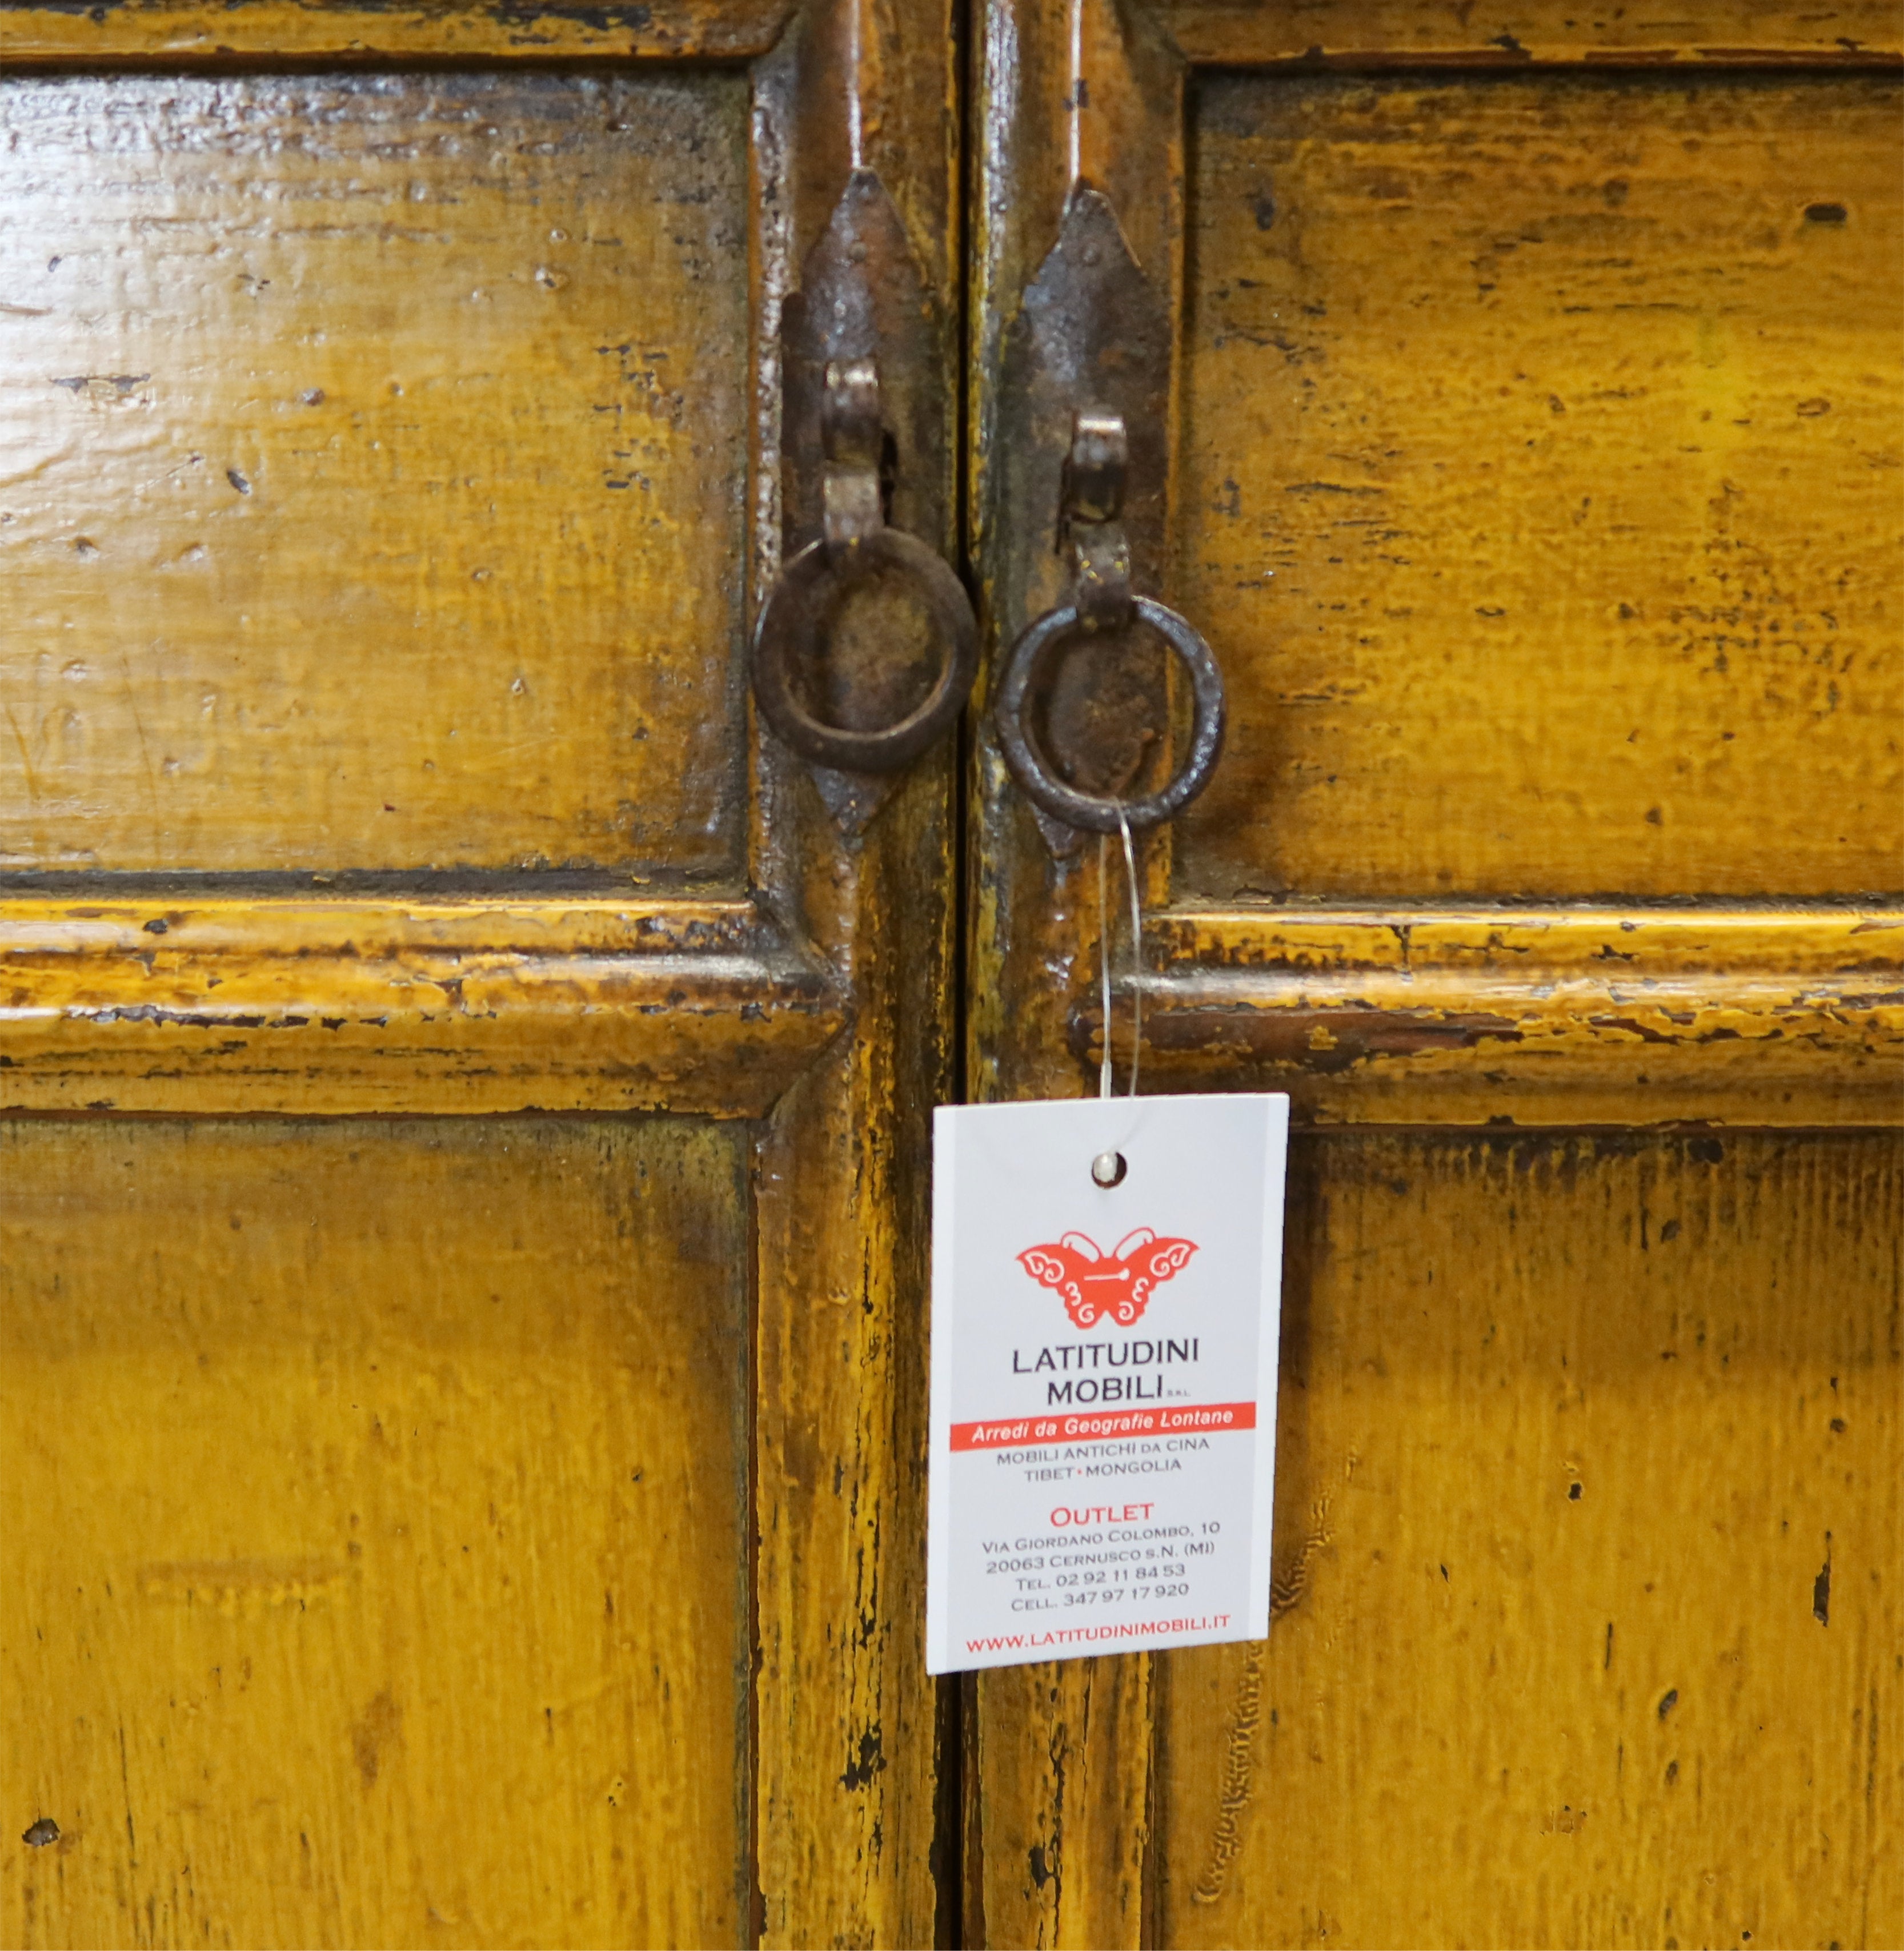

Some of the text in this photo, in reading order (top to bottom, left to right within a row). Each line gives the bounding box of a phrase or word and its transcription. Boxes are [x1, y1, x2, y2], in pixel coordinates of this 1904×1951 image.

[1013, 1338, 1200, 1374] LATITUDINI
[1047, 1375, 1164, 1406] MOBILI
[971, 1408, 1233, 1443] Arredi da Geografie Lontane
[996, 1448, 1059, 1466] MOBILI
[1063, 1443, 1137, 1460] ANTICHI
[1167, 1438, 1209, 1451] CINA
[1025, 1459, 1182, 1483] TIBET MONGOLIA
[1050, 1503, 1155, 1527] OUTLET
[1201, 1522, 1220, 1535] 10
[986, 1557, 1044, 1573] 20063
[1184, 1541, 1215, 1557] (MI)
[1056, 1574, 1079, 1587] 02
[1083, 1572, 1105, 1585] 92
[1113, 1570, 1129, 1581] 11
[1136, 1567, 1158, 1580] 84
[1163, 1564, 1185, 1576] 53
[1064, 1593, 1097, 1607] 347
[1101, 1589, 1123, 1603] 97
[1132, 1587, 1152, 1599] 17
[1156, 1584, 1189, 1597] 920
[966, 1615, 1230, 1653] WWW.LATITUDINIMOBILI.IT
